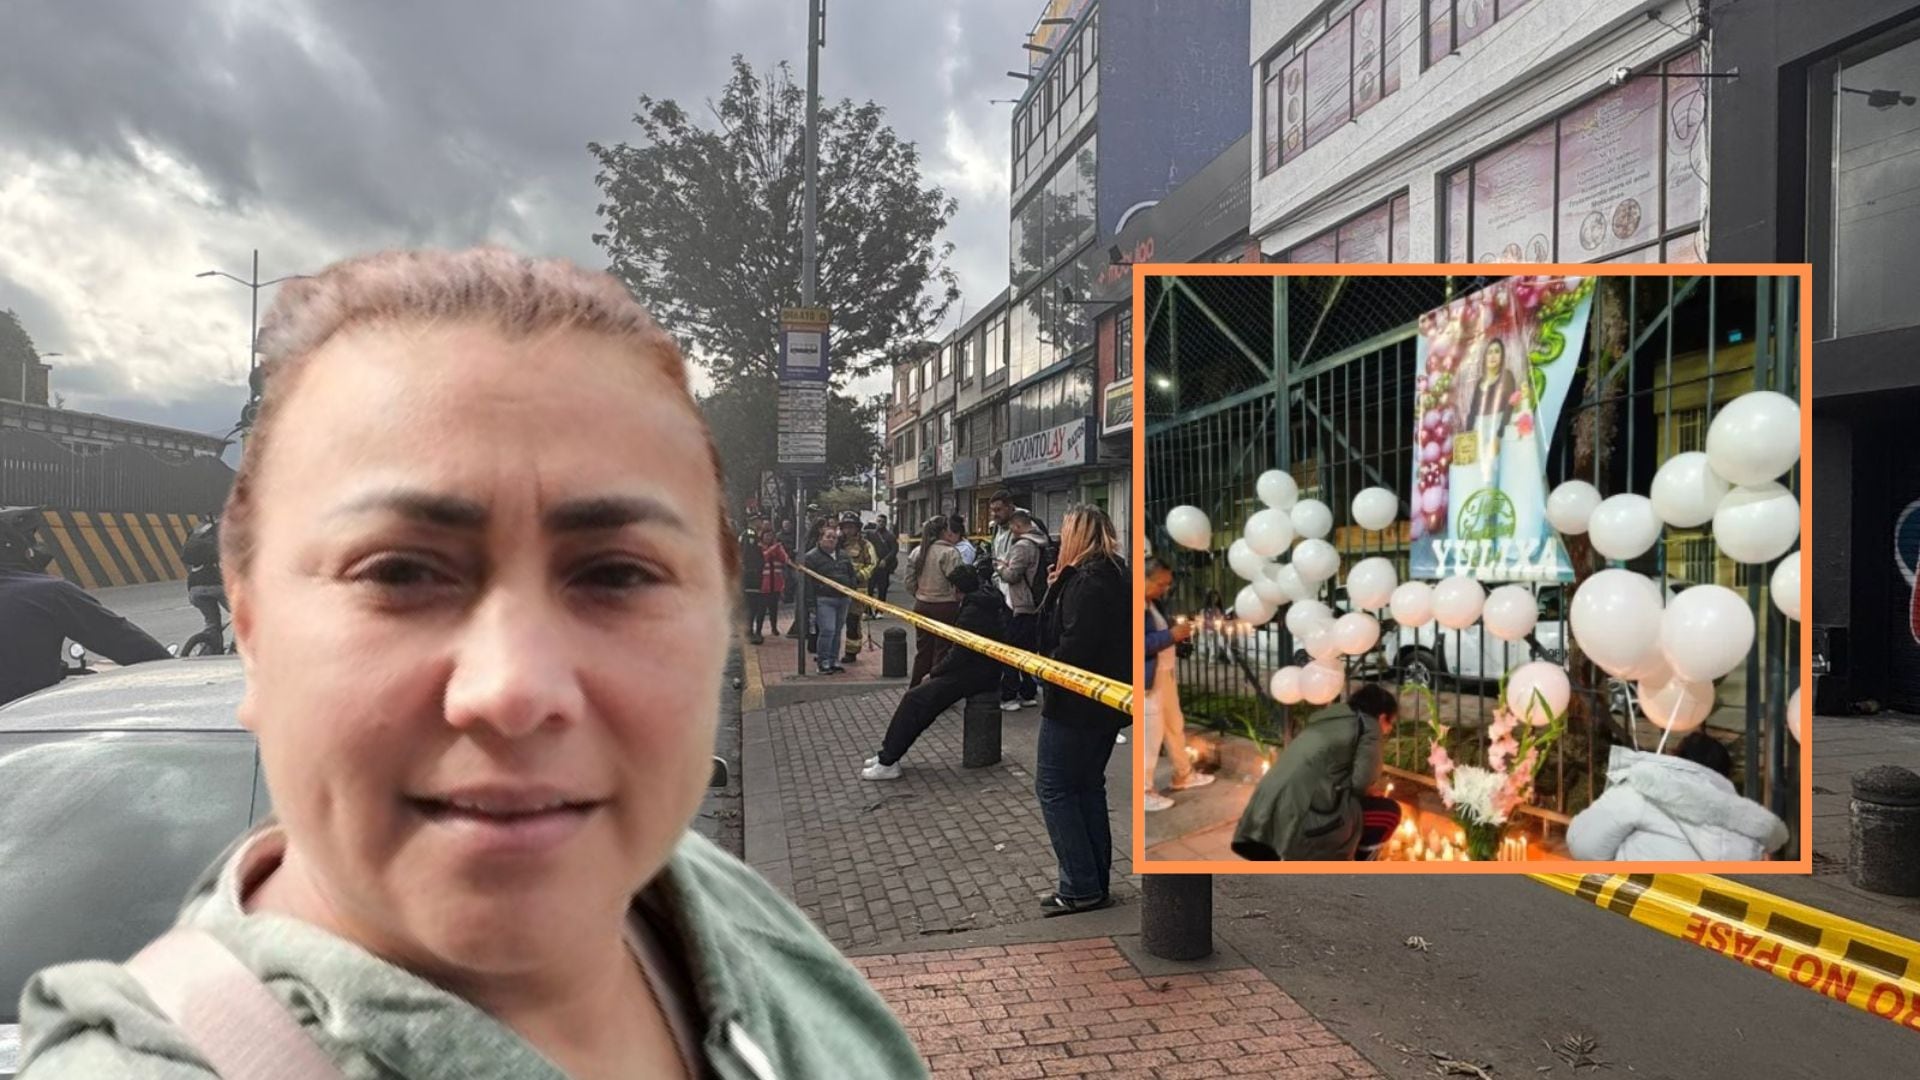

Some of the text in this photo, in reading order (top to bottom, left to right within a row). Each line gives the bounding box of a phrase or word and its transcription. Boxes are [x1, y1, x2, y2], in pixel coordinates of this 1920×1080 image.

[1009, 426, 1067, 464] ODONTOLAY
[1432, 537, 1557, 580] YULIXA
[1681, 912, 1783, 974] PASE
[1788, 953, 1857, 1003] NO
